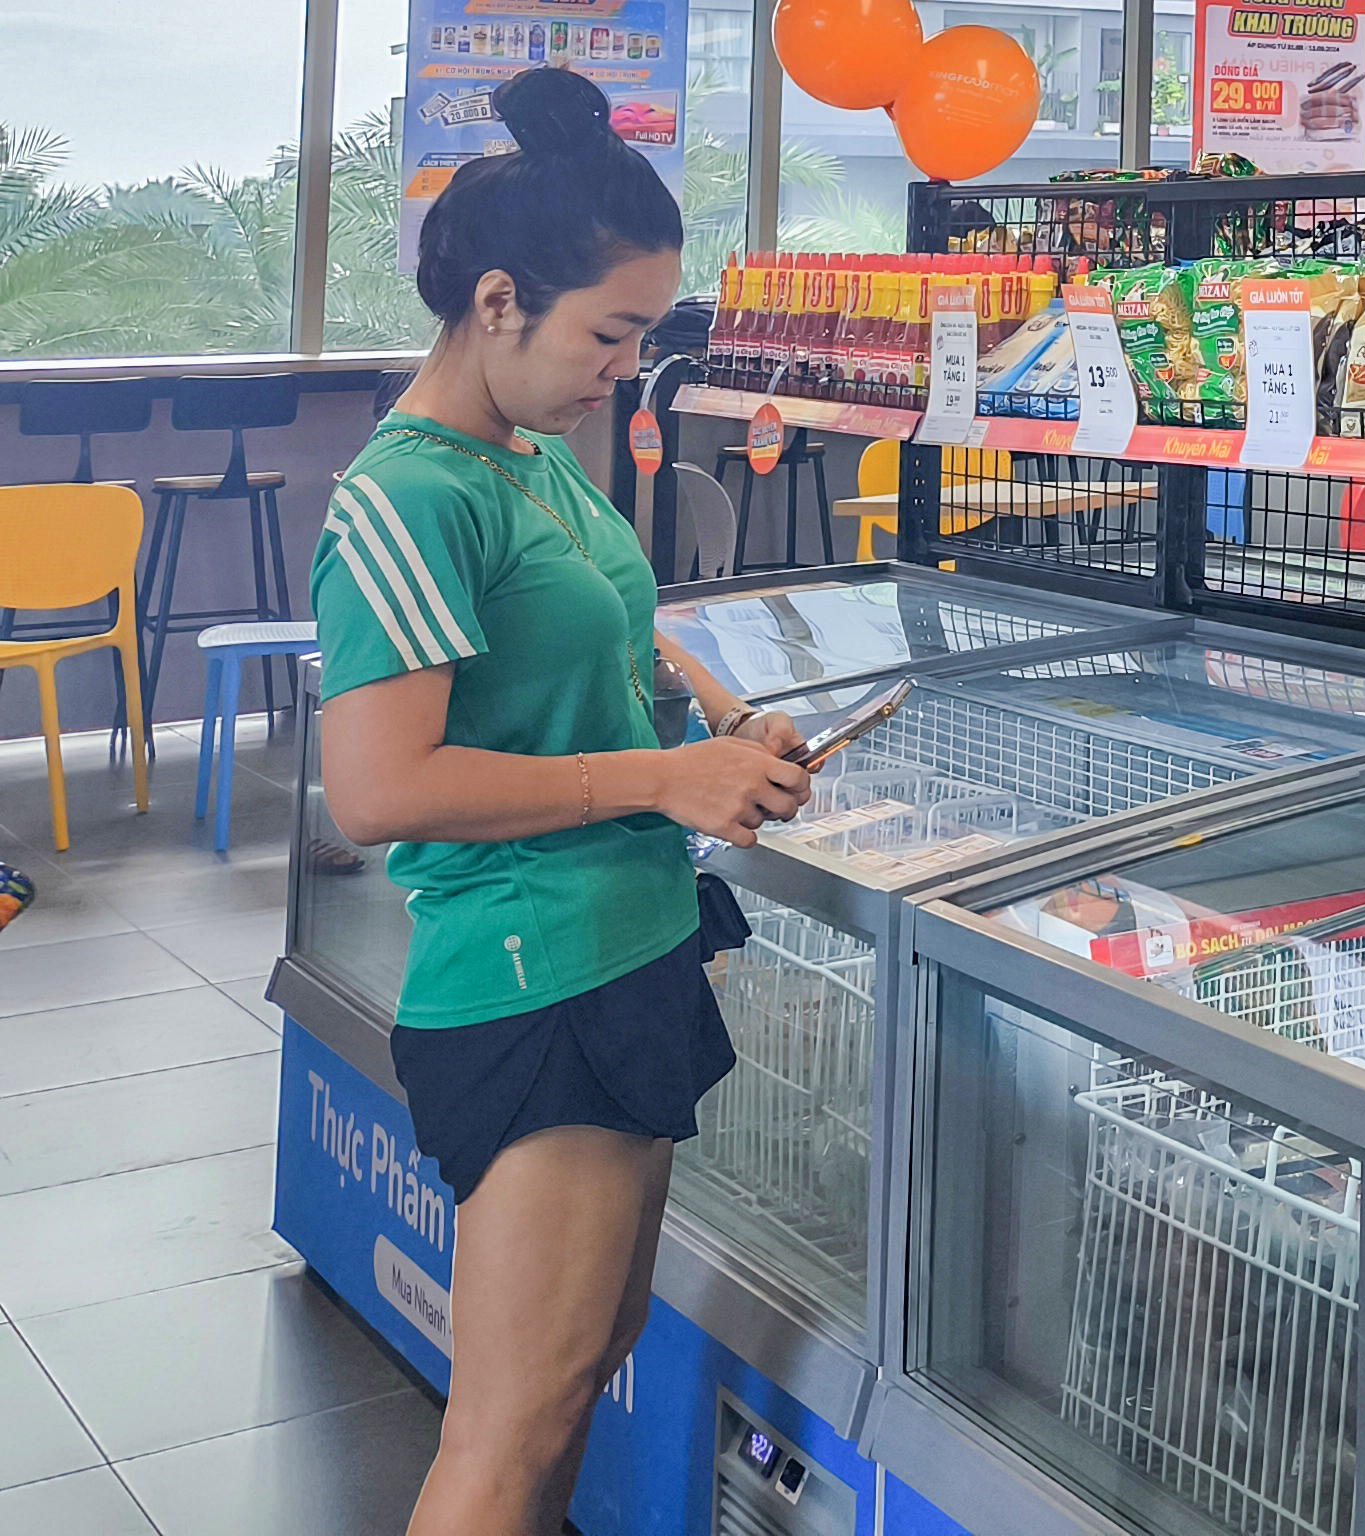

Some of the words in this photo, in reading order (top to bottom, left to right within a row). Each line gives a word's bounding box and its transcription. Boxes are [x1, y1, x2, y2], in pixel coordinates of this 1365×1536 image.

[1233, 12, 1278, 33] KHAI
[1283, 14, 1354, 38] TRƯƠNG
[1243, 64, 1258, 77] GIÁ
[450, 108, 478, 121] 20.000
[1250, 288, 1265, 304] GIÁ
[1289, 286, 1304, 303] TỐT
[1117, 303, 1149, 316] MEIZAN
[946, 355, 960, 365] MUA
[962, 356, 965, 366] 1
[1264, 363, 1284, 375] MUA
[1288, 365, 1292, 376] 1
[962, 372, 965, 381] 1
[1291, 383, 1295, 395] 1
[1163, 434, 1206, 457] Khuyến
[1210, 439, 1231, 458] Mãi
[308, 1069, 365, 1188] Thực
[371, 1123, 446, 1252] Phẩm
[392, 1262, 412, 1306] Mua
[414, 1289, 447, 1338] Nhanh
